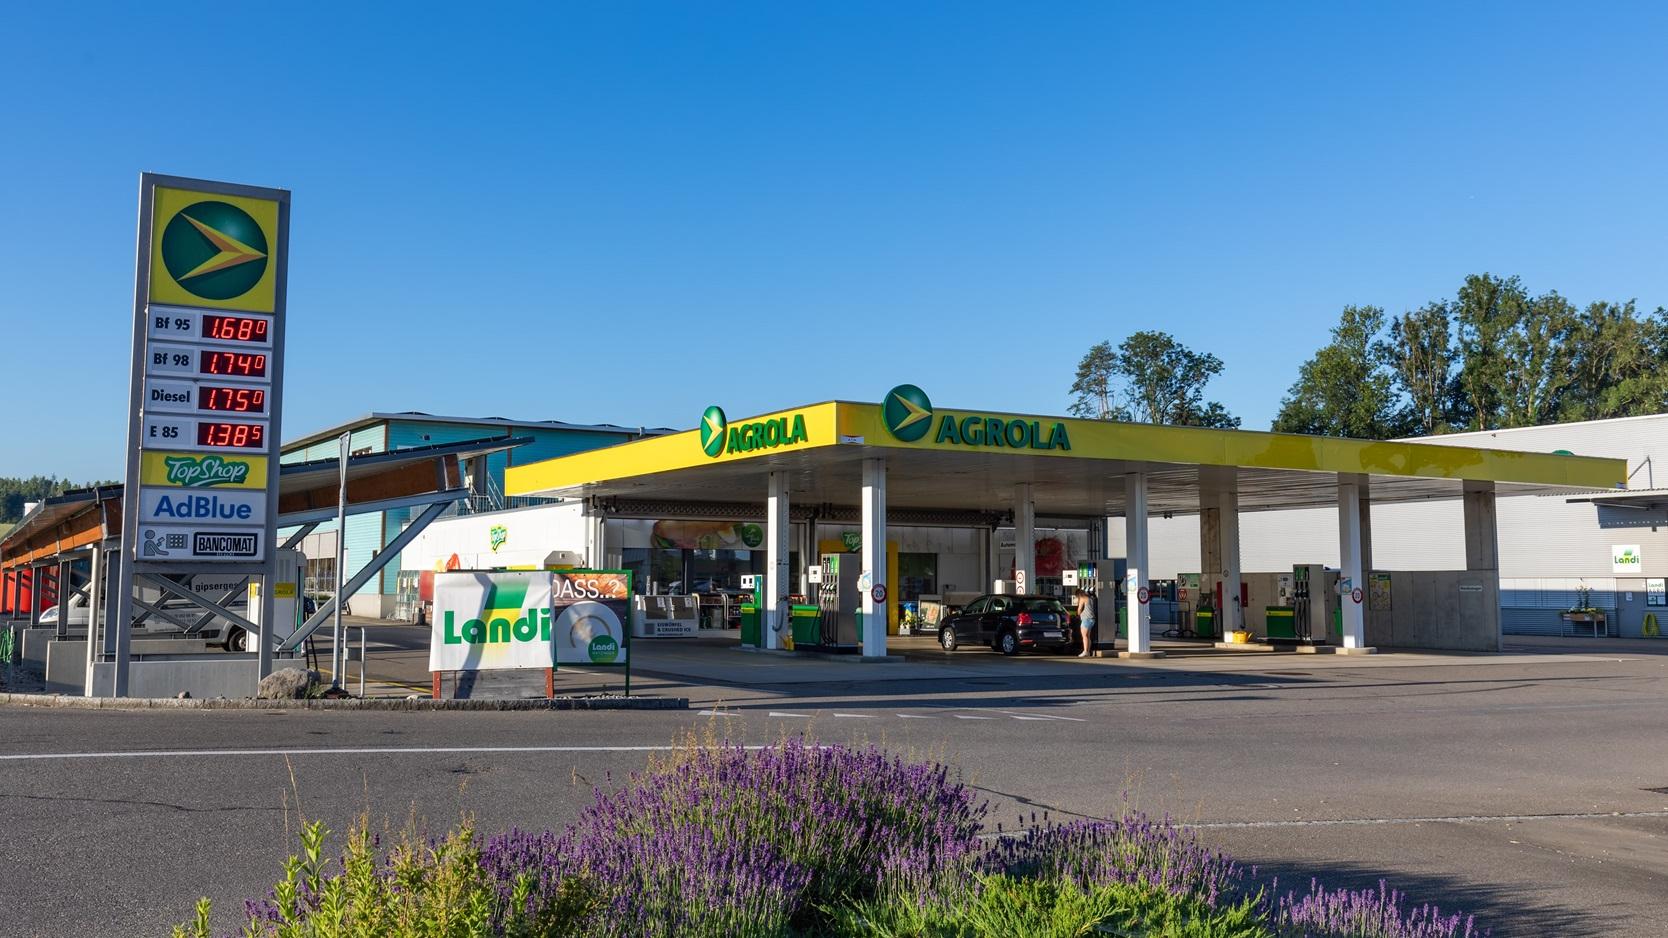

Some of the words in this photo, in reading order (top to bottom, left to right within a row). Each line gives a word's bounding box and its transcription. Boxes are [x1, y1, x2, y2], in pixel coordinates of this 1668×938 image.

[155, 317, 170, 329] Bf
[175, 318, 190, 330] 95
[153, 353, 168, 365] Bf
[173, 354, 190, 366] 98
[151, 389, 191, 403] Diesel
[150, 425, 157, 437] E
[162, 426, 179, 438] 85
[727, 414, 808, 454] AGROLA
[936, 415, 1071, 450] AGROLA
[153, 495, 252, 519] AdBlue
[198, 536, 254, 552] BANCOMAT
[1614, 556, 1640, 564] Landi
[444, 608, 551, 645] Landi
